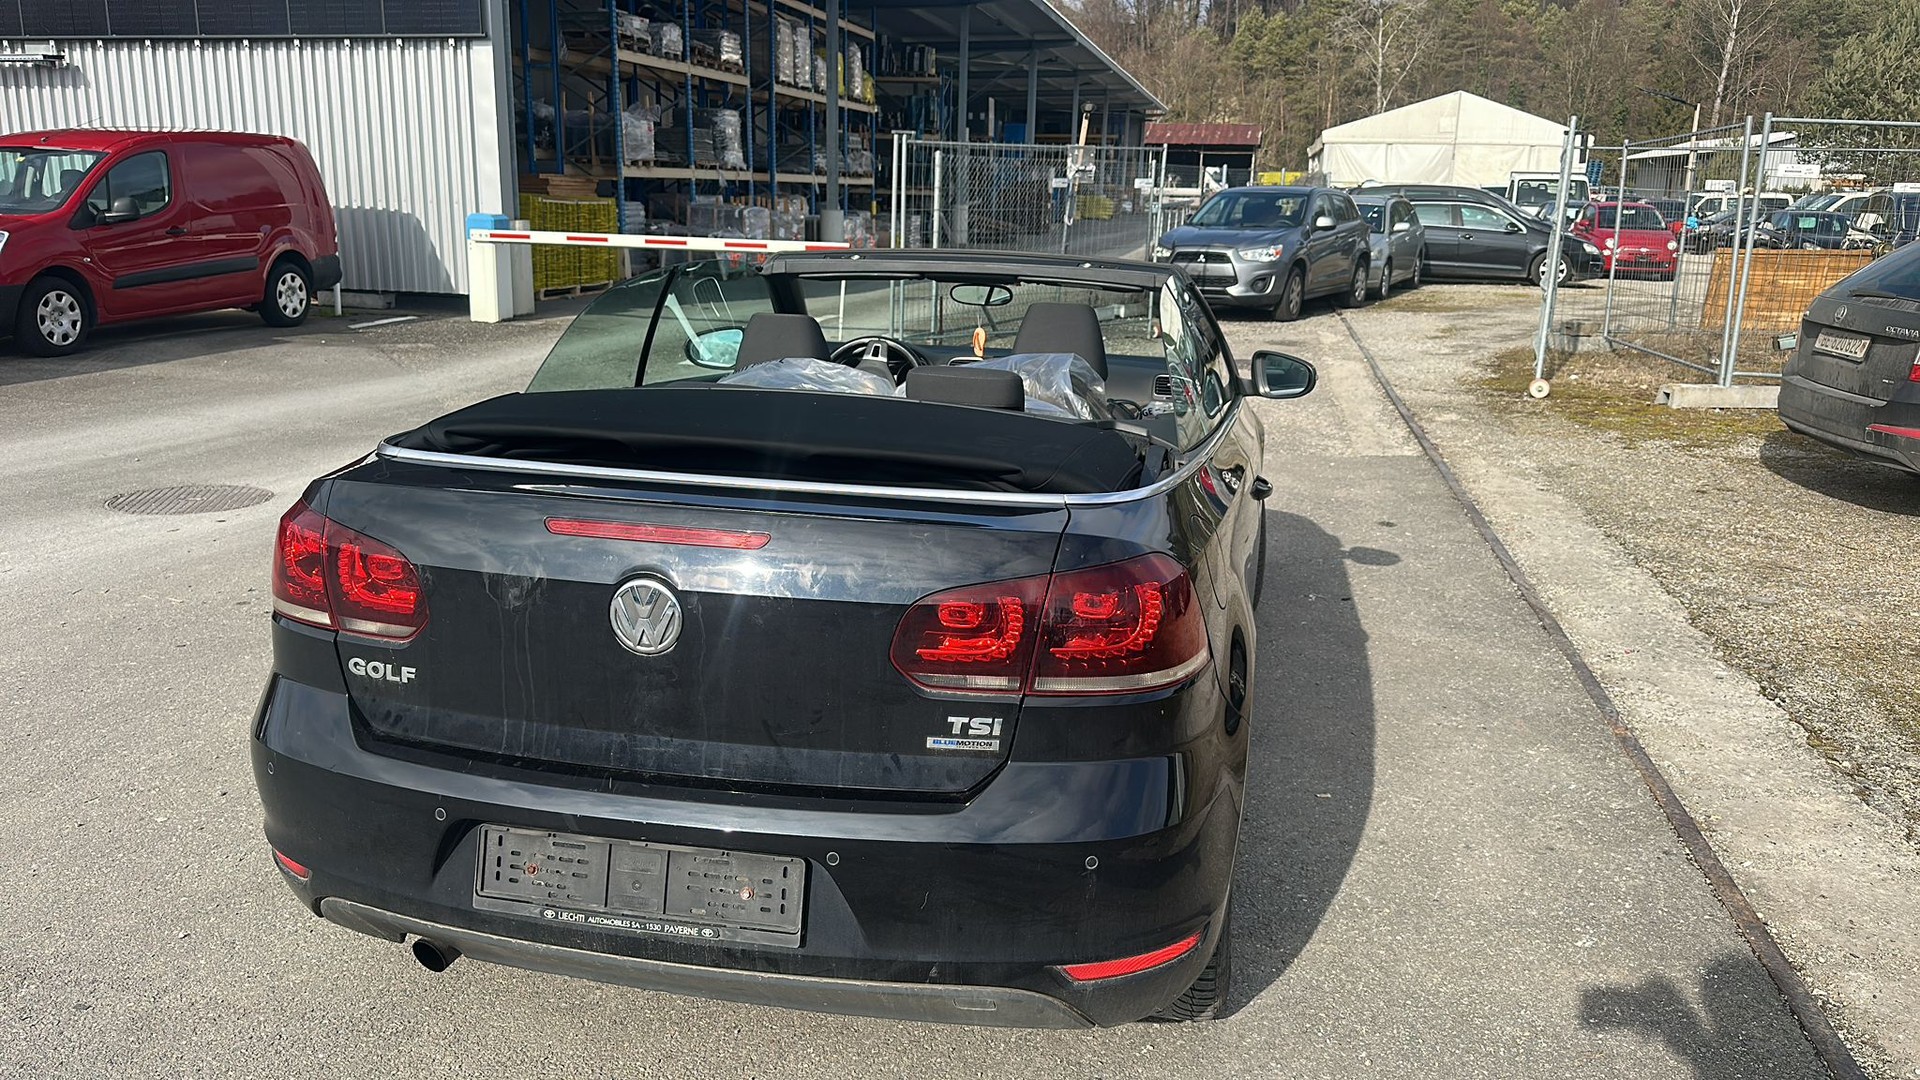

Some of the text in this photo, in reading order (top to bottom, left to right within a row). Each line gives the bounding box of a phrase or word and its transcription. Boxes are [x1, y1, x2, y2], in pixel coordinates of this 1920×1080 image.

[1885, 325, 1919, 337] OCTAVIA
[347, 657, 417, 685] GOLF
[947, 716, 1003, 736] TSI
[932, 739, 993, 748] BLUEMOTION
[557, 911, 585, 923] LIECHTI
[587, 916, 630, 928] AUTOMOBILES
[631, 921, 641, 929] SA
[646, 923, 662, 931] 1530
[664, 924, 699, 936] PAYERNE
